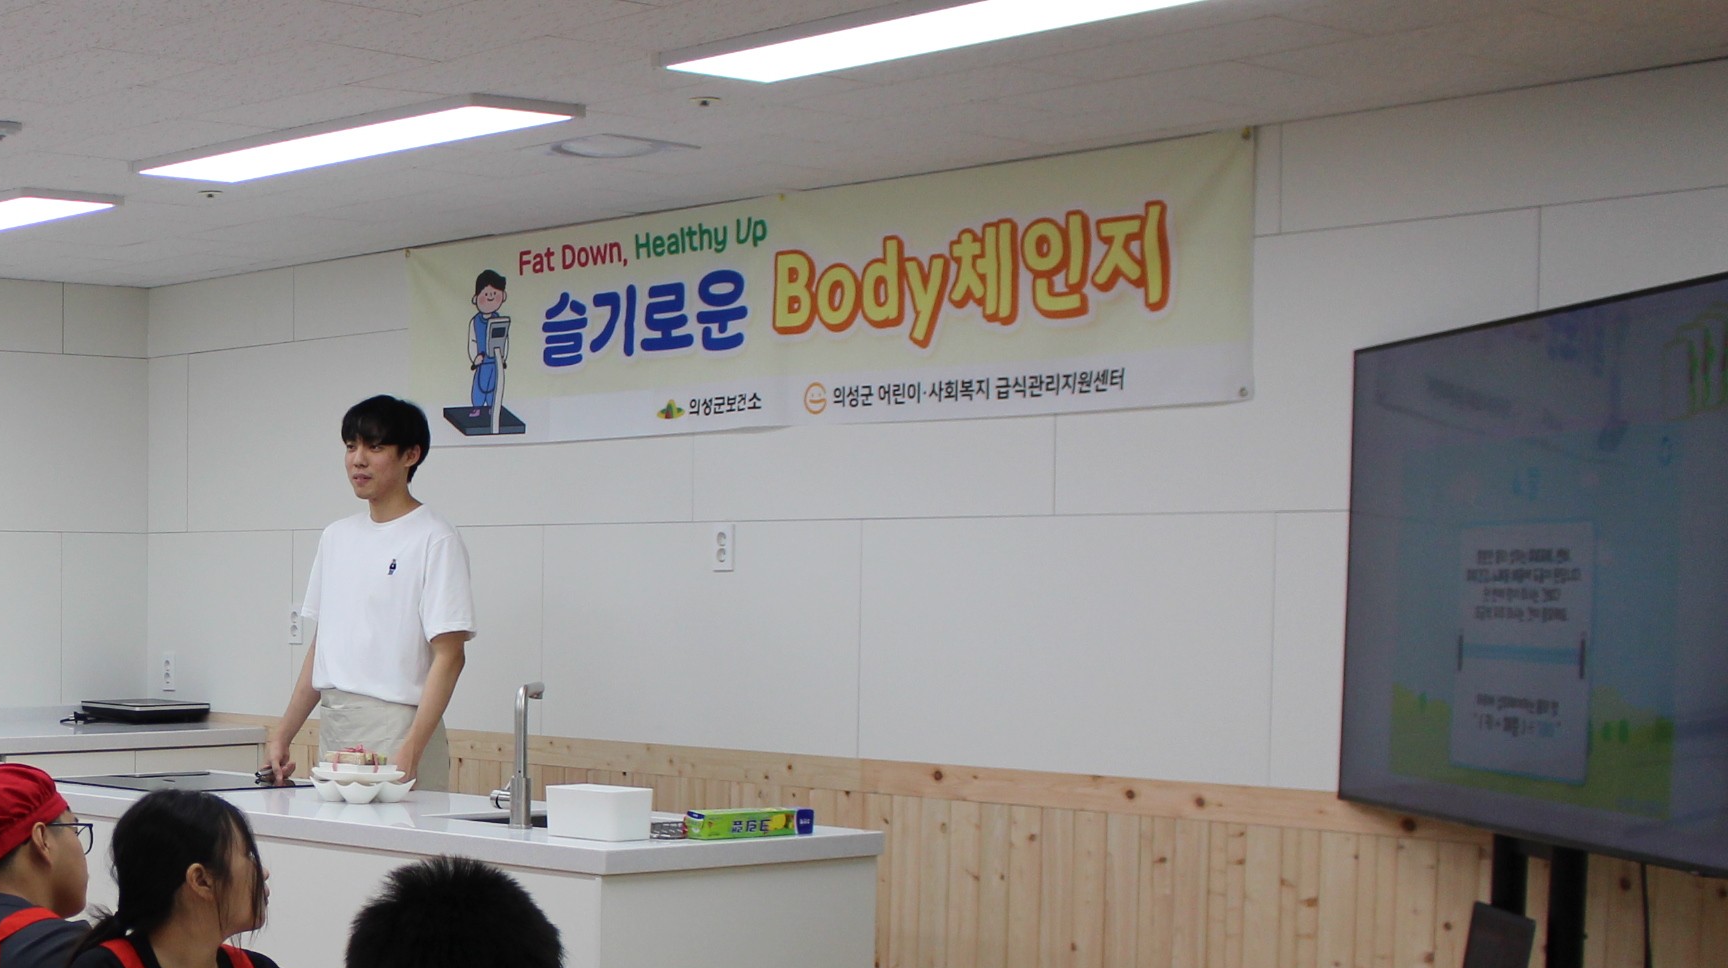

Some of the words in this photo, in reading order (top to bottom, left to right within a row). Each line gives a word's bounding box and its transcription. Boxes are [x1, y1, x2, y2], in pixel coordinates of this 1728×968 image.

[519, 247, 555, 276] Fat
[562, 241, 628, 271] Down,
[635, 223, 727, 260] Healthy
[736, 217, 767, 247] Up
[542, 269, 748, 367] 슬기로운
[773, 200, 1171, 349] Body체인지
[688, 392, 762, 416] 의성군보건소
[833, 385, 874, 407] 의성군
[995, 367, 1126, 399] 급식관리지원센터
